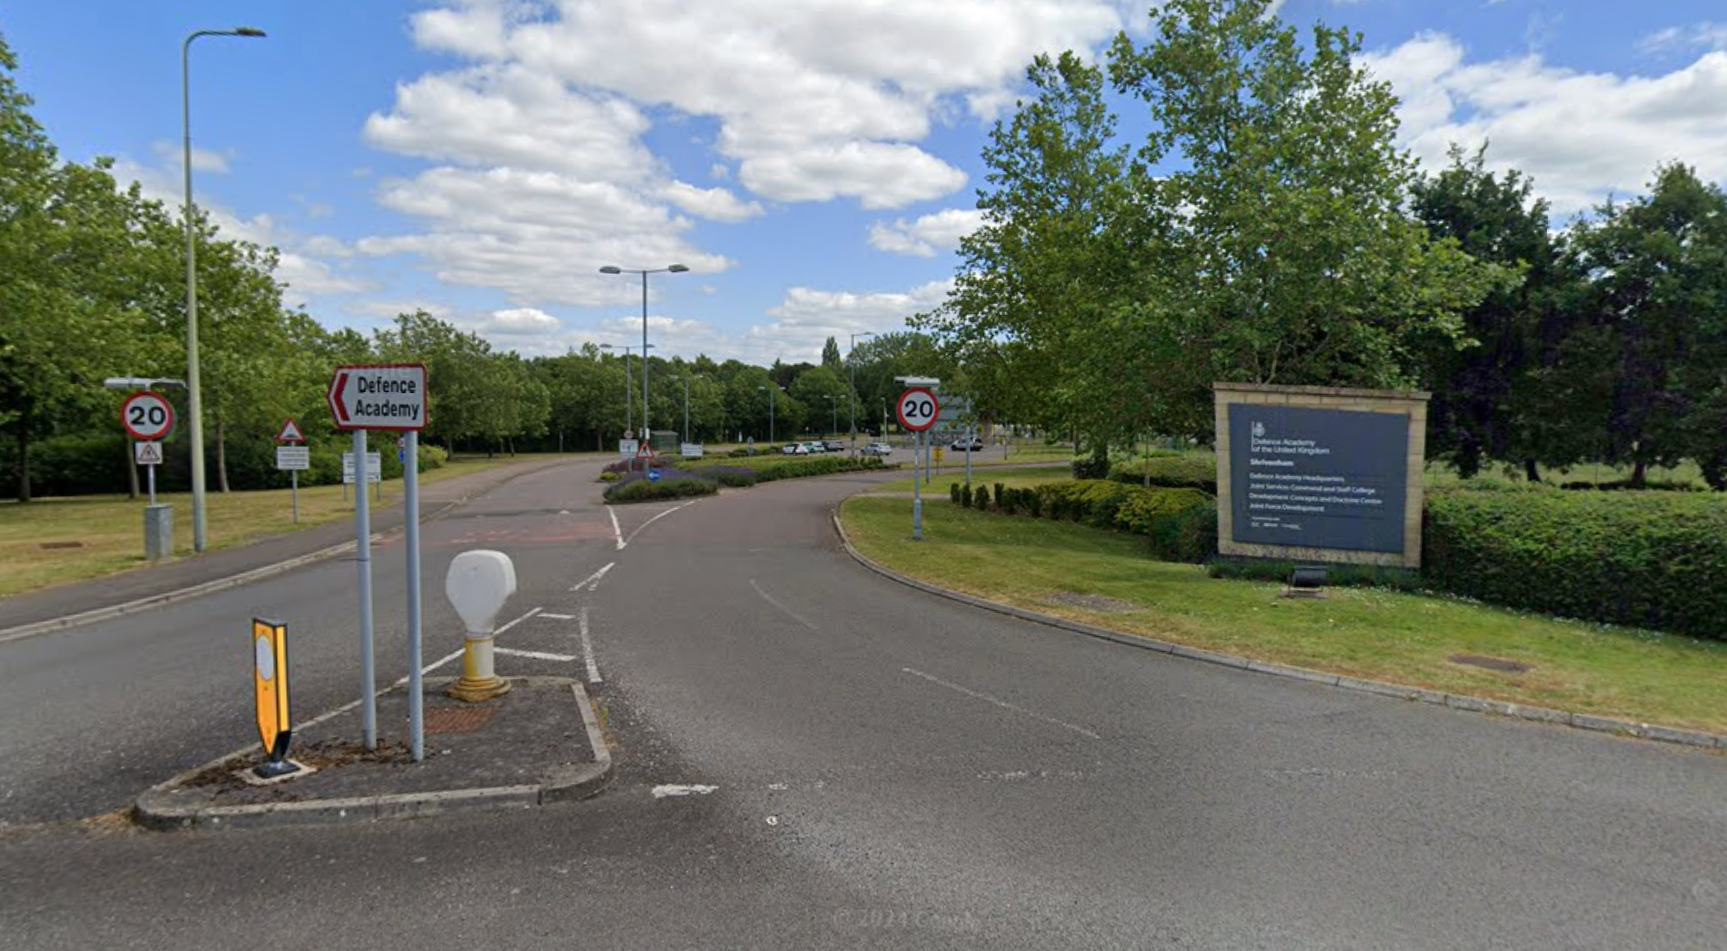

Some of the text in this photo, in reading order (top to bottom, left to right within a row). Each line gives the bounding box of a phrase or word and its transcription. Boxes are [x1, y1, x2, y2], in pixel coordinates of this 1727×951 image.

[357, 376, 416, 394] Defence
[354, 399, 420, 421] Academy
[905, 400, 933, 418] 20
[129, 406, 166, 426] 20
[1253, 438, 1316, 448] Defence Academy
[1297, 447, 1330, 456] Kingdom
[1250, 458, 1294, 467] Shrivenham
[1274, 474, 1302, 482] Academy
[1290, 484, 1323, 492] Command
[1351, 486, 1376, 496] College
[1290, 494, 1319, 503] Concepts
[1282, 504, 1325, 512] Development
